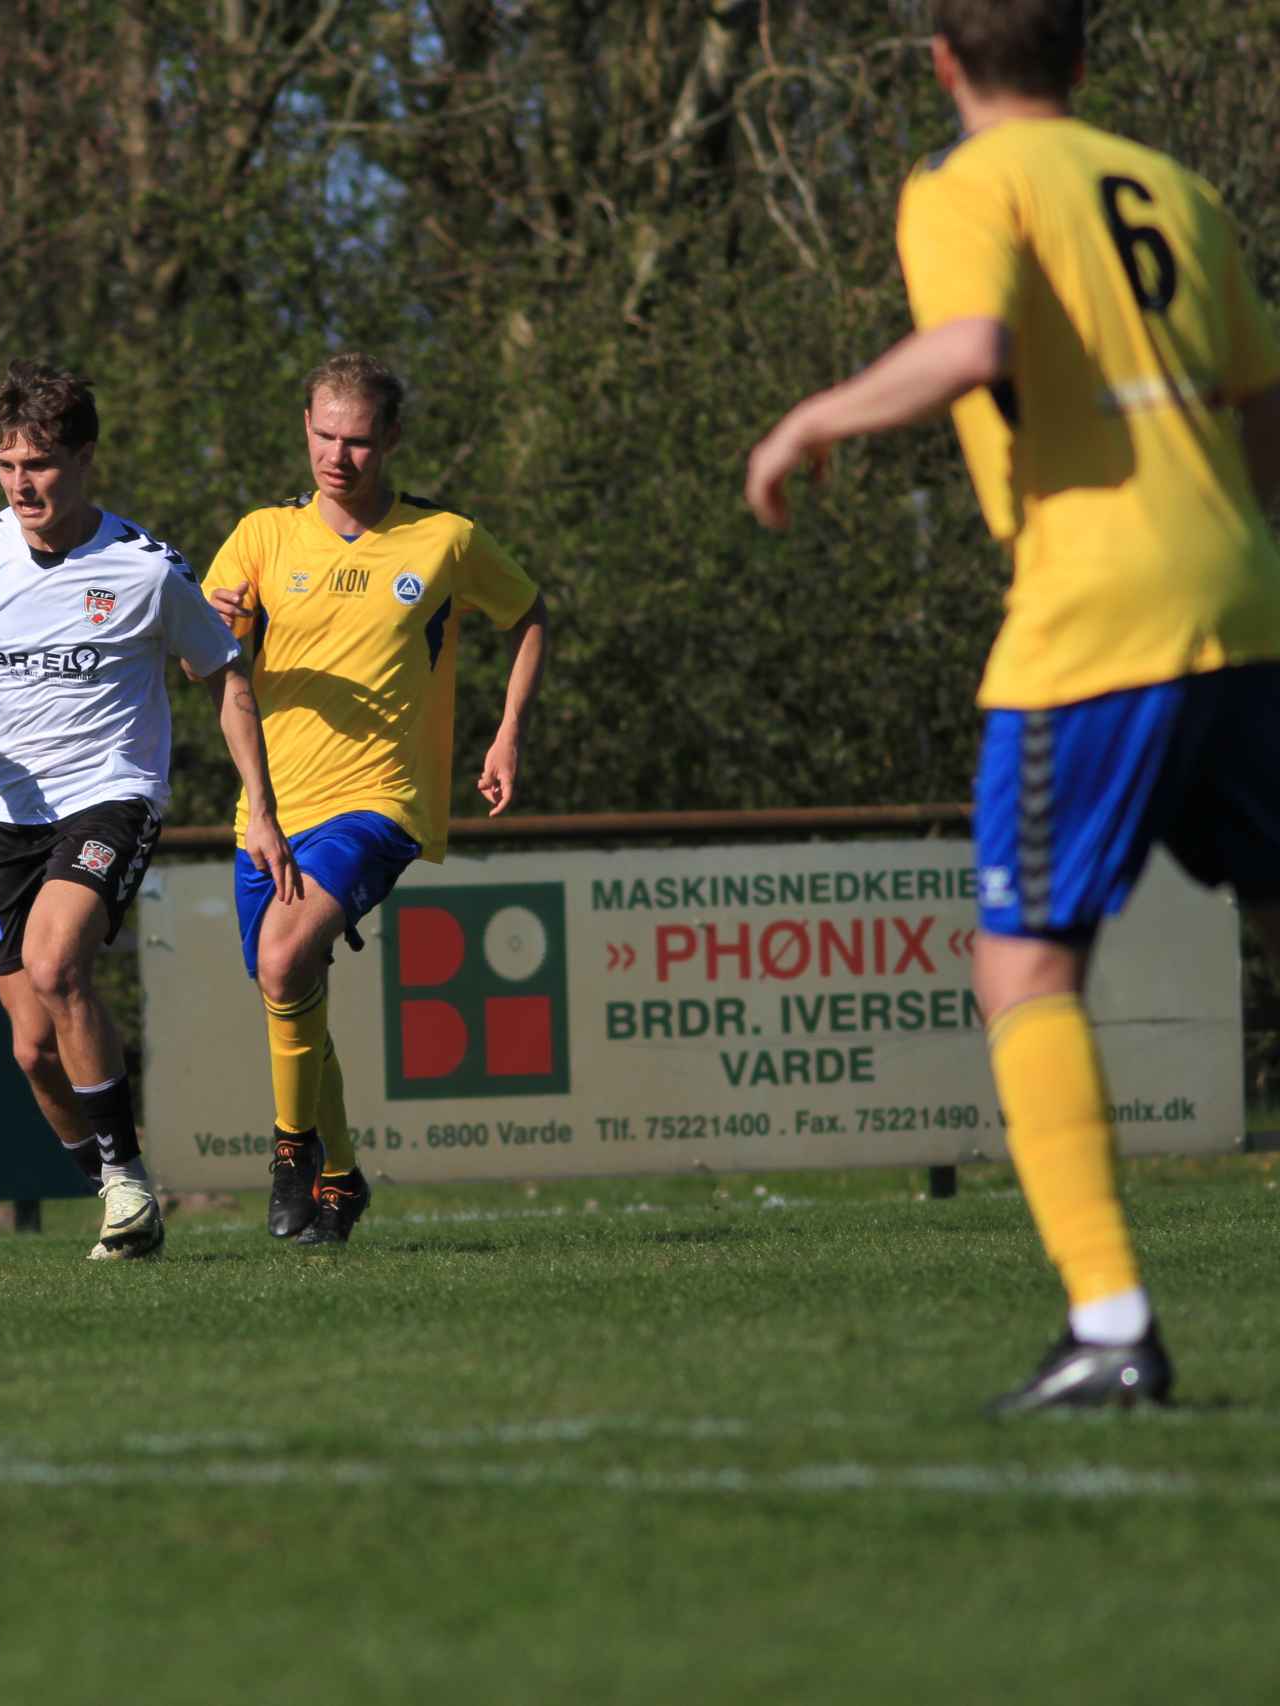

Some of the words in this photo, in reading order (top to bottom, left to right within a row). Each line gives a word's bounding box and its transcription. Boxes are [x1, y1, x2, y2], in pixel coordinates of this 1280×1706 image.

[1100, 175, 1175, 313] 6
[592, 867, 977, 911] MASKINSNEDKERIE
[656, 915, 937, 983] PHØNIX
[606, 997, 761, 1041] BRDR.
[719, 1046, 875, 1087] VARDE
[426, 1122, 488, 1148] 6800
[496, 1118, 573, 1146] Varde
[595, 1117, 636, 1142] Tlf.
[644, 1112, 770, 1141] 75221400
[795, 1108, 847, 1135] Fax.
[855, 1104, 978, 1133] 75221490
